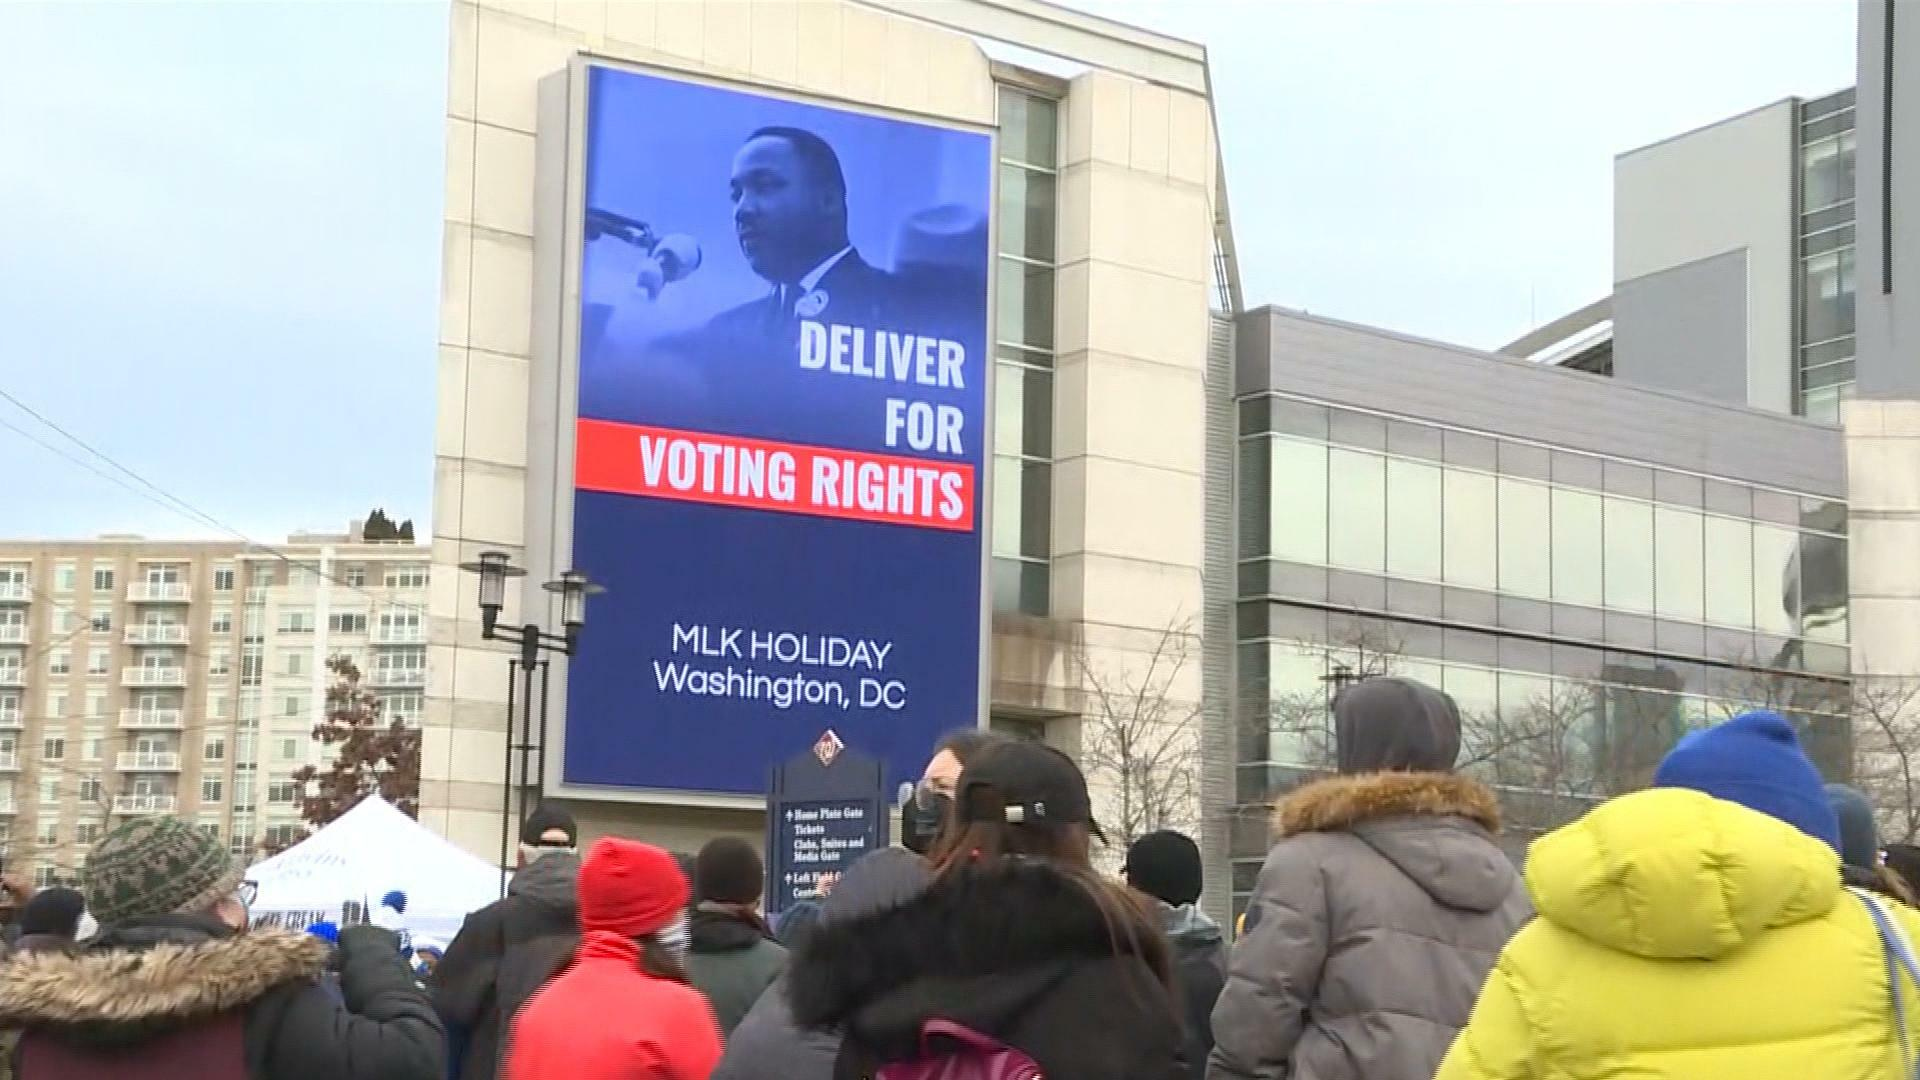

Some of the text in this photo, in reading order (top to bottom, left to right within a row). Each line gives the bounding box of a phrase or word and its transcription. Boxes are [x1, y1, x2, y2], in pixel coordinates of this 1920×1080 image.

[799, 320, 966, 389] DELIVER
[885, 399, 963, 455] FOR
[640, 435, 963, 521] VOTING RIGHTS
[672, 624, 892, 671] MLK HOLIDAY
[653, 661, 906, 710] Washington, DC
[794, 807, 863, 820] Home Plate Gate
[794, 824, 825, 835] Tickets
[821, 837, 847, 848] Suites
[849, 835, 864, 848] and
[794, 850, 840, 862] Media Gate
[793, 872, 810, 883] Left
